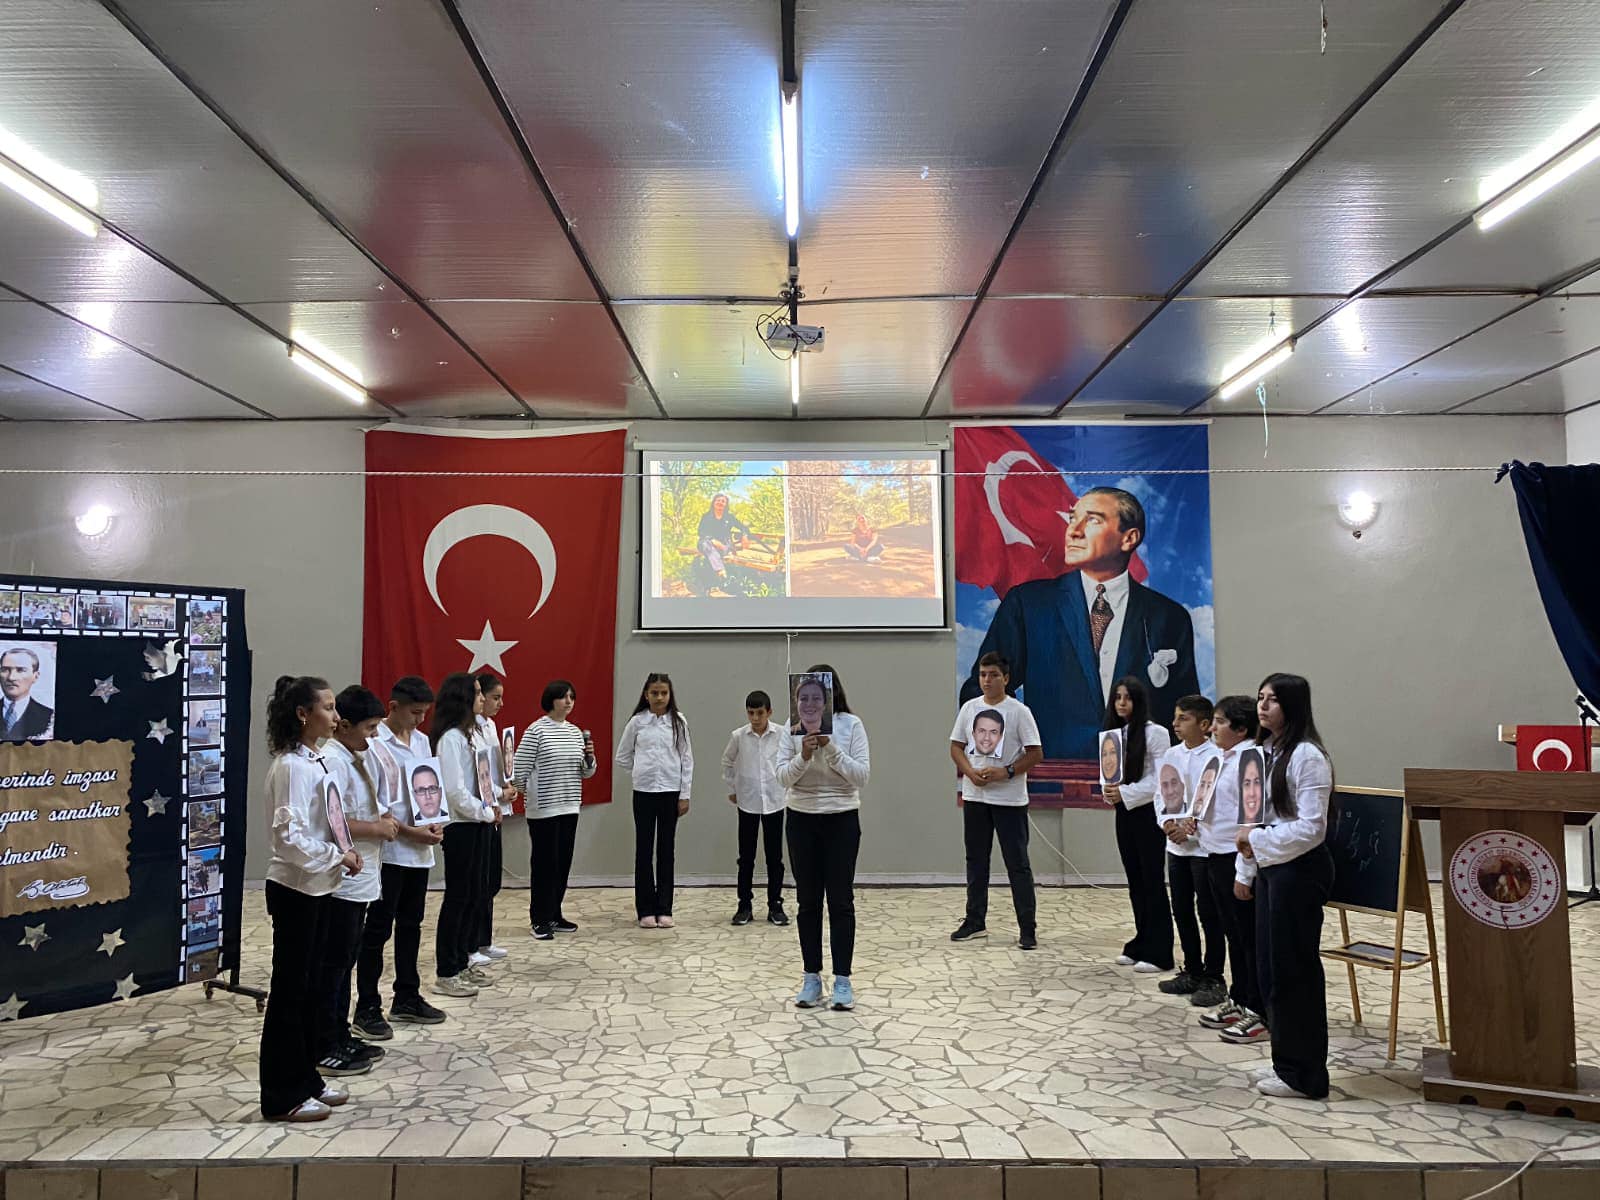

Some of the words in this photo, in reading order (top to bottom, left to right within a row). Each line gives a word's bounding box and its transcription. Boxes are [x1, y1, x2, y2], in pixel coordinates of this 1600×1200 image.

[0, 769, 56, 788] erinde
[61, 769, 118, 792] imzası
[48, 801, 121, 823] sanatkar
